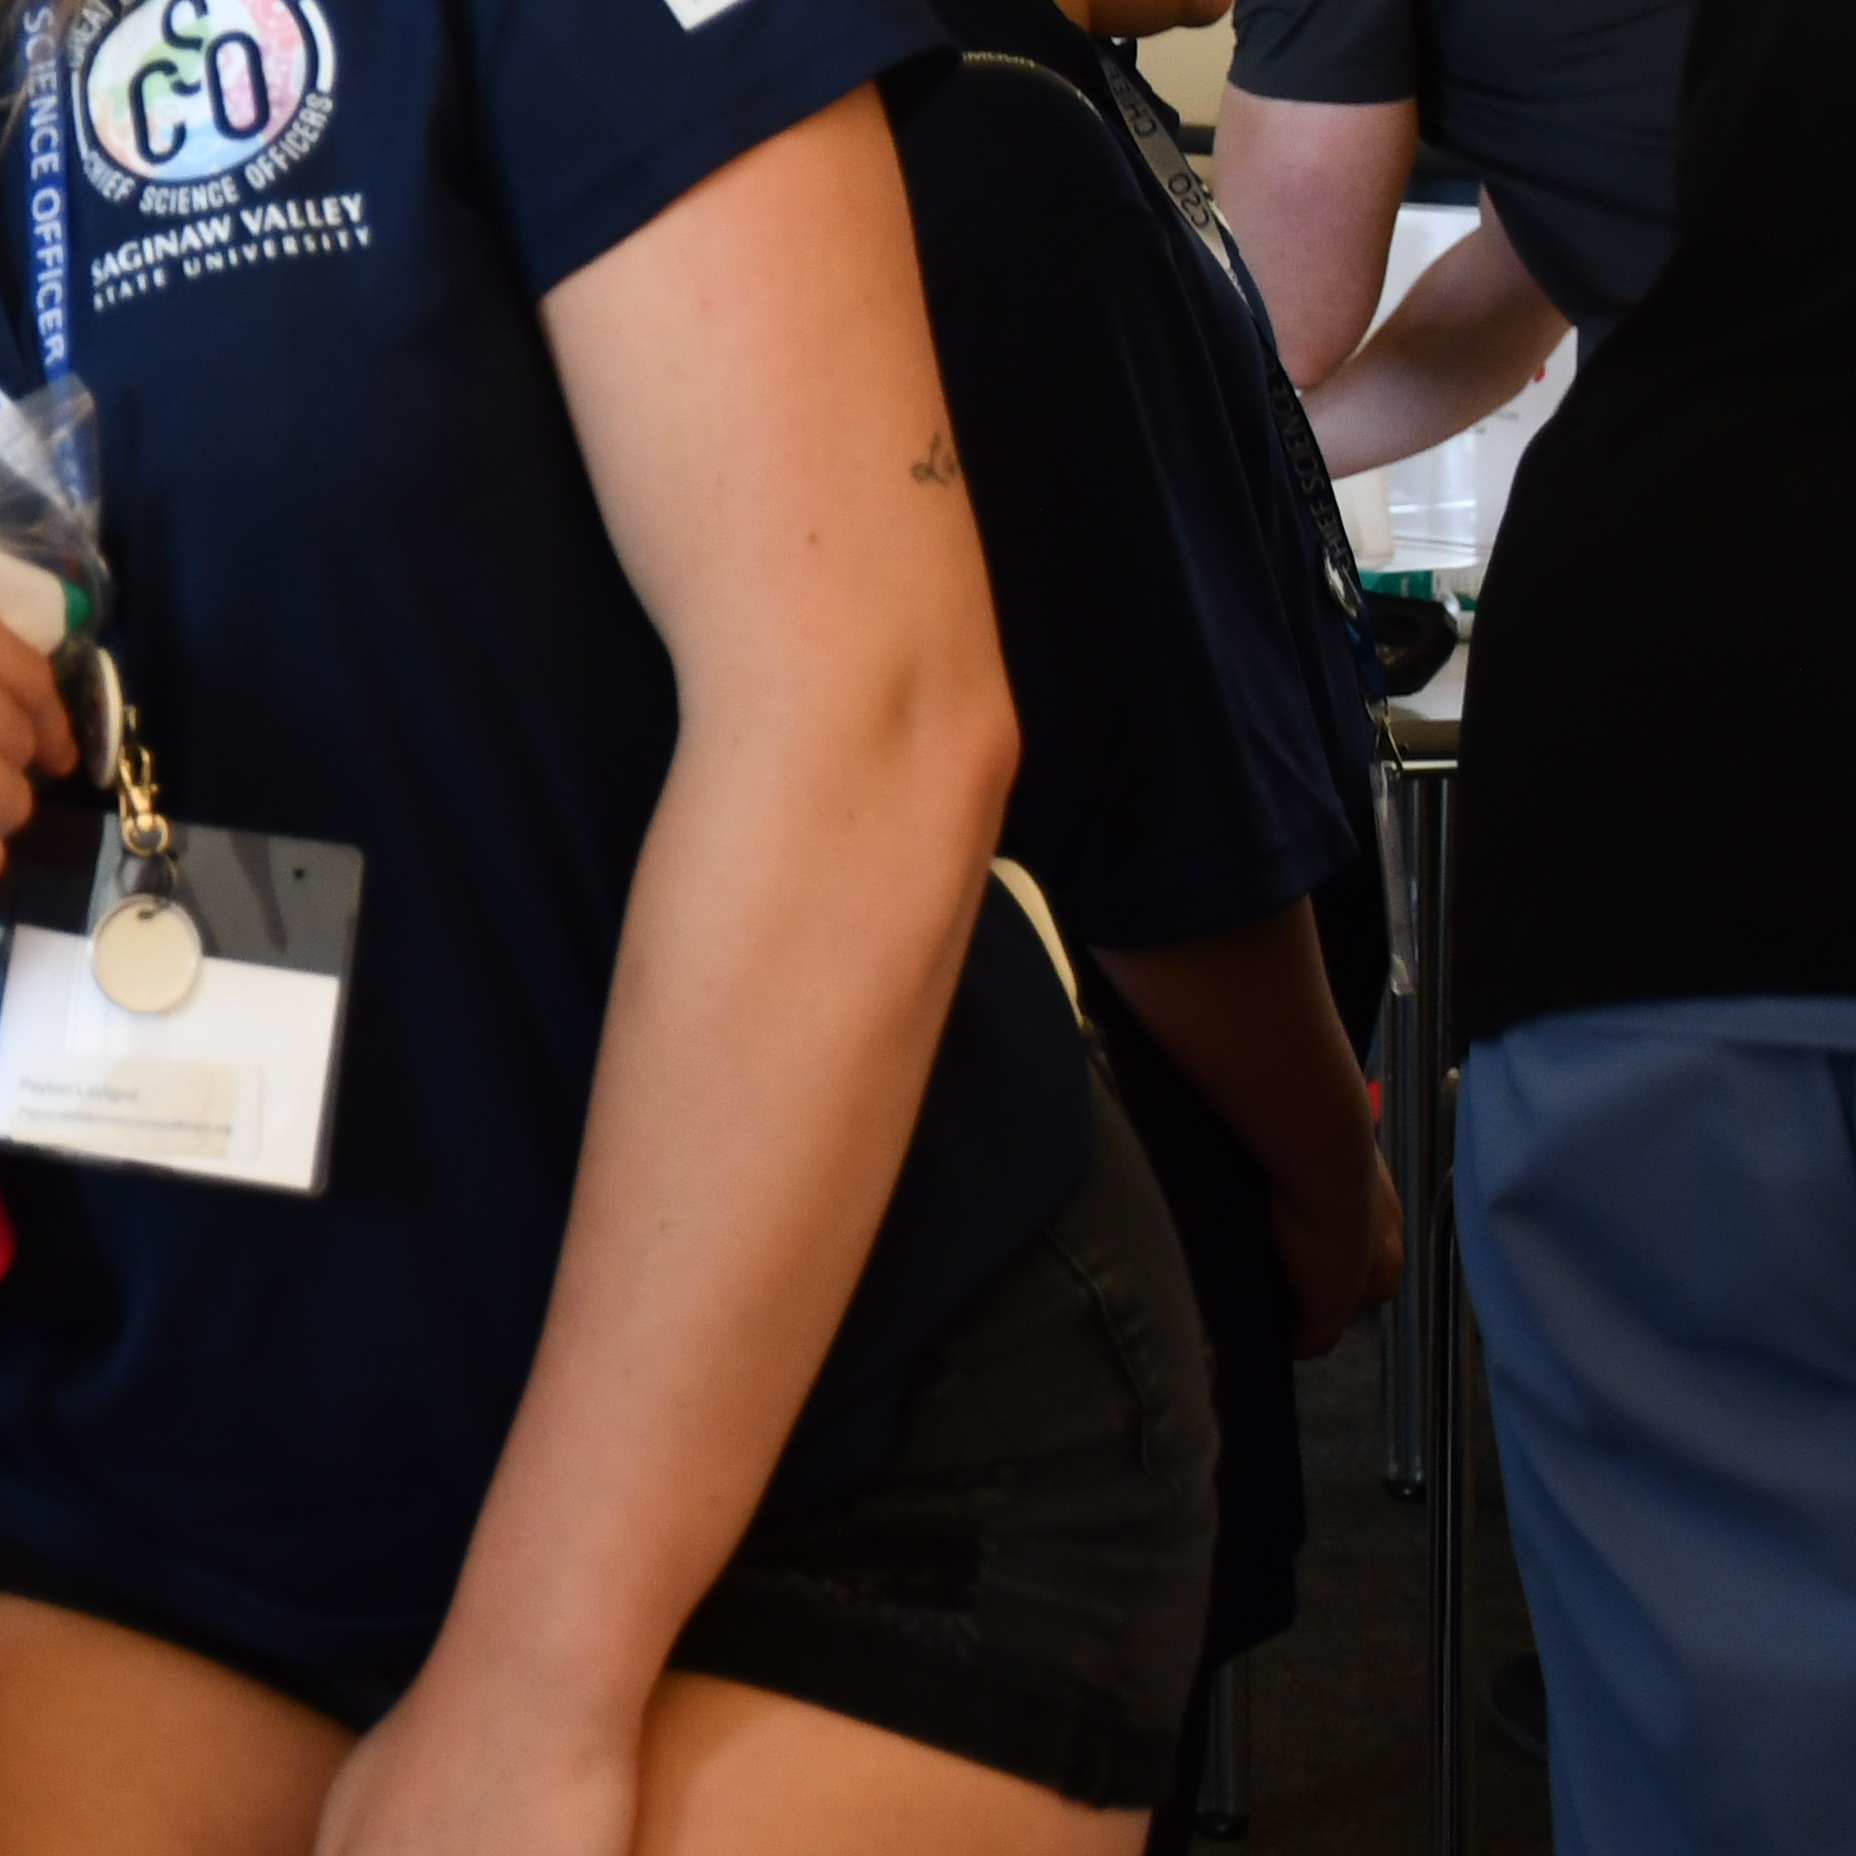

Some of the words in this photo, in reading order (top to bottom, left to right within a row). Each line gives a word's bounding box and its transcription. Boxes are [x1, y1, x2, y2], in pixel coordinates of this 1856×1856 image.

[22, 6, 62, 181] SCIENCE
[81, 148, 138, 204] CHIEF
[138, 175, 241, 217] SCIENCE
[243, 88, 335, 192] OFFICERS
[30, 187, 67, 366] OFFICER
[89, 213, 233, 290] SAGINAW
[238, 189, 367, 240] VALLEY
[92, 272, 169, 317] STATE
[182, 221, 372, 279] UNIVERSITY
